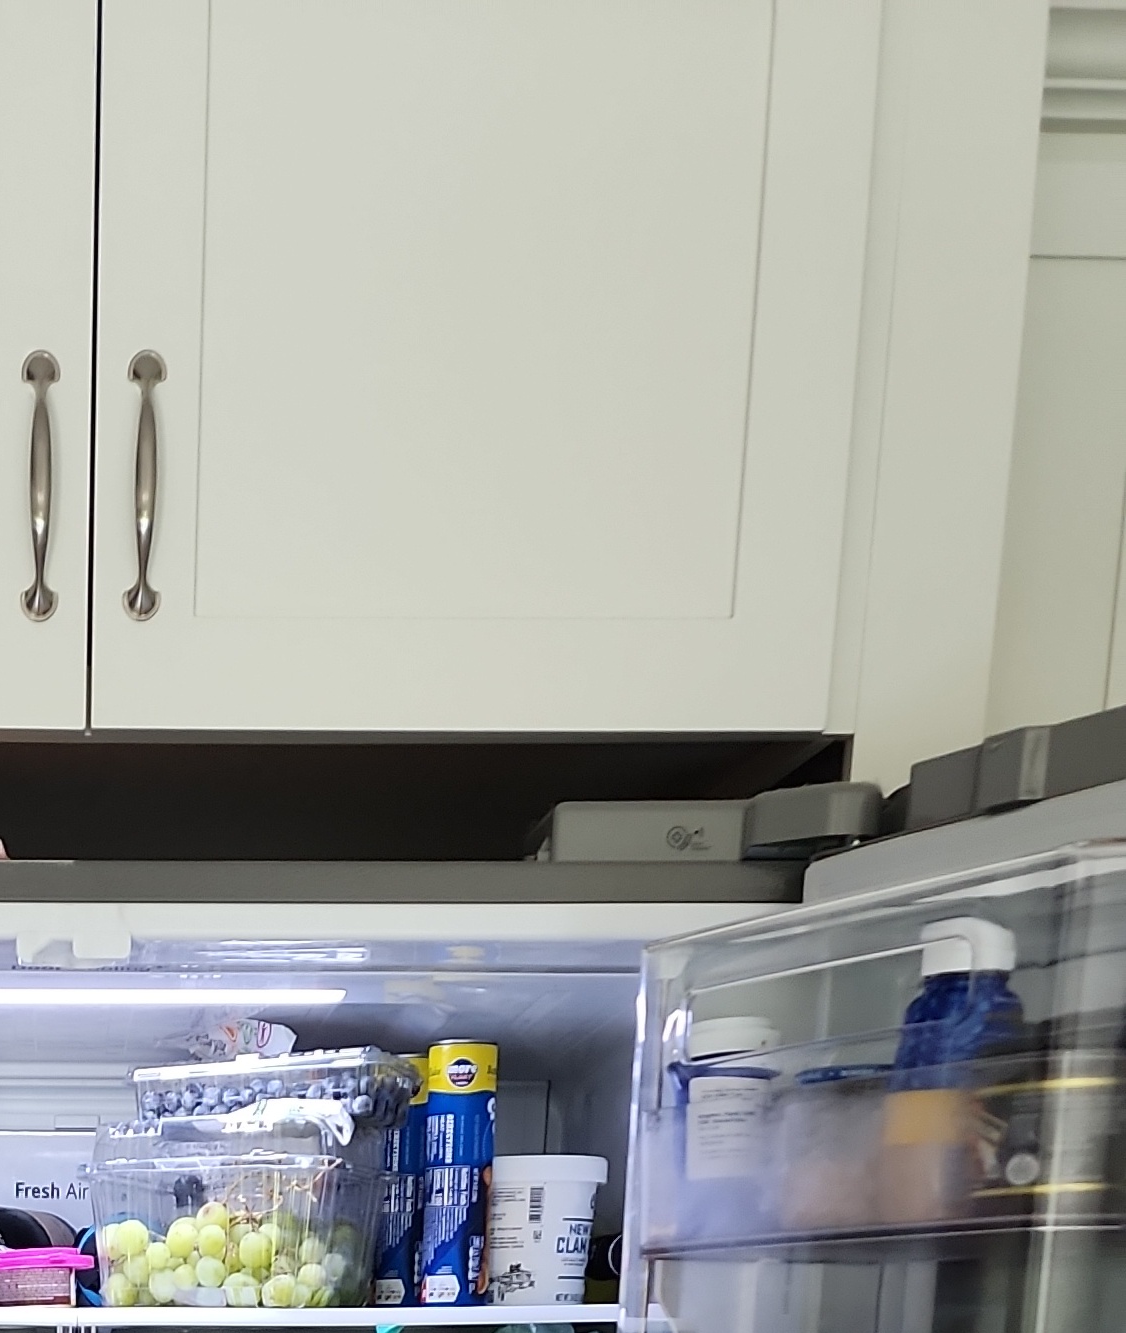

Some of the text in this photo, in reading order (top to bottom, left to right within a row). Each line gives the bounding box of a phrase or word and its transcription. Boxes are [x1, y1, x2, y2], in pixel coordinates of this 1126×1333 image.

[14, 1181, 90, 1200] Fresh Air
[568, 1223, 590, 1236] NEW
